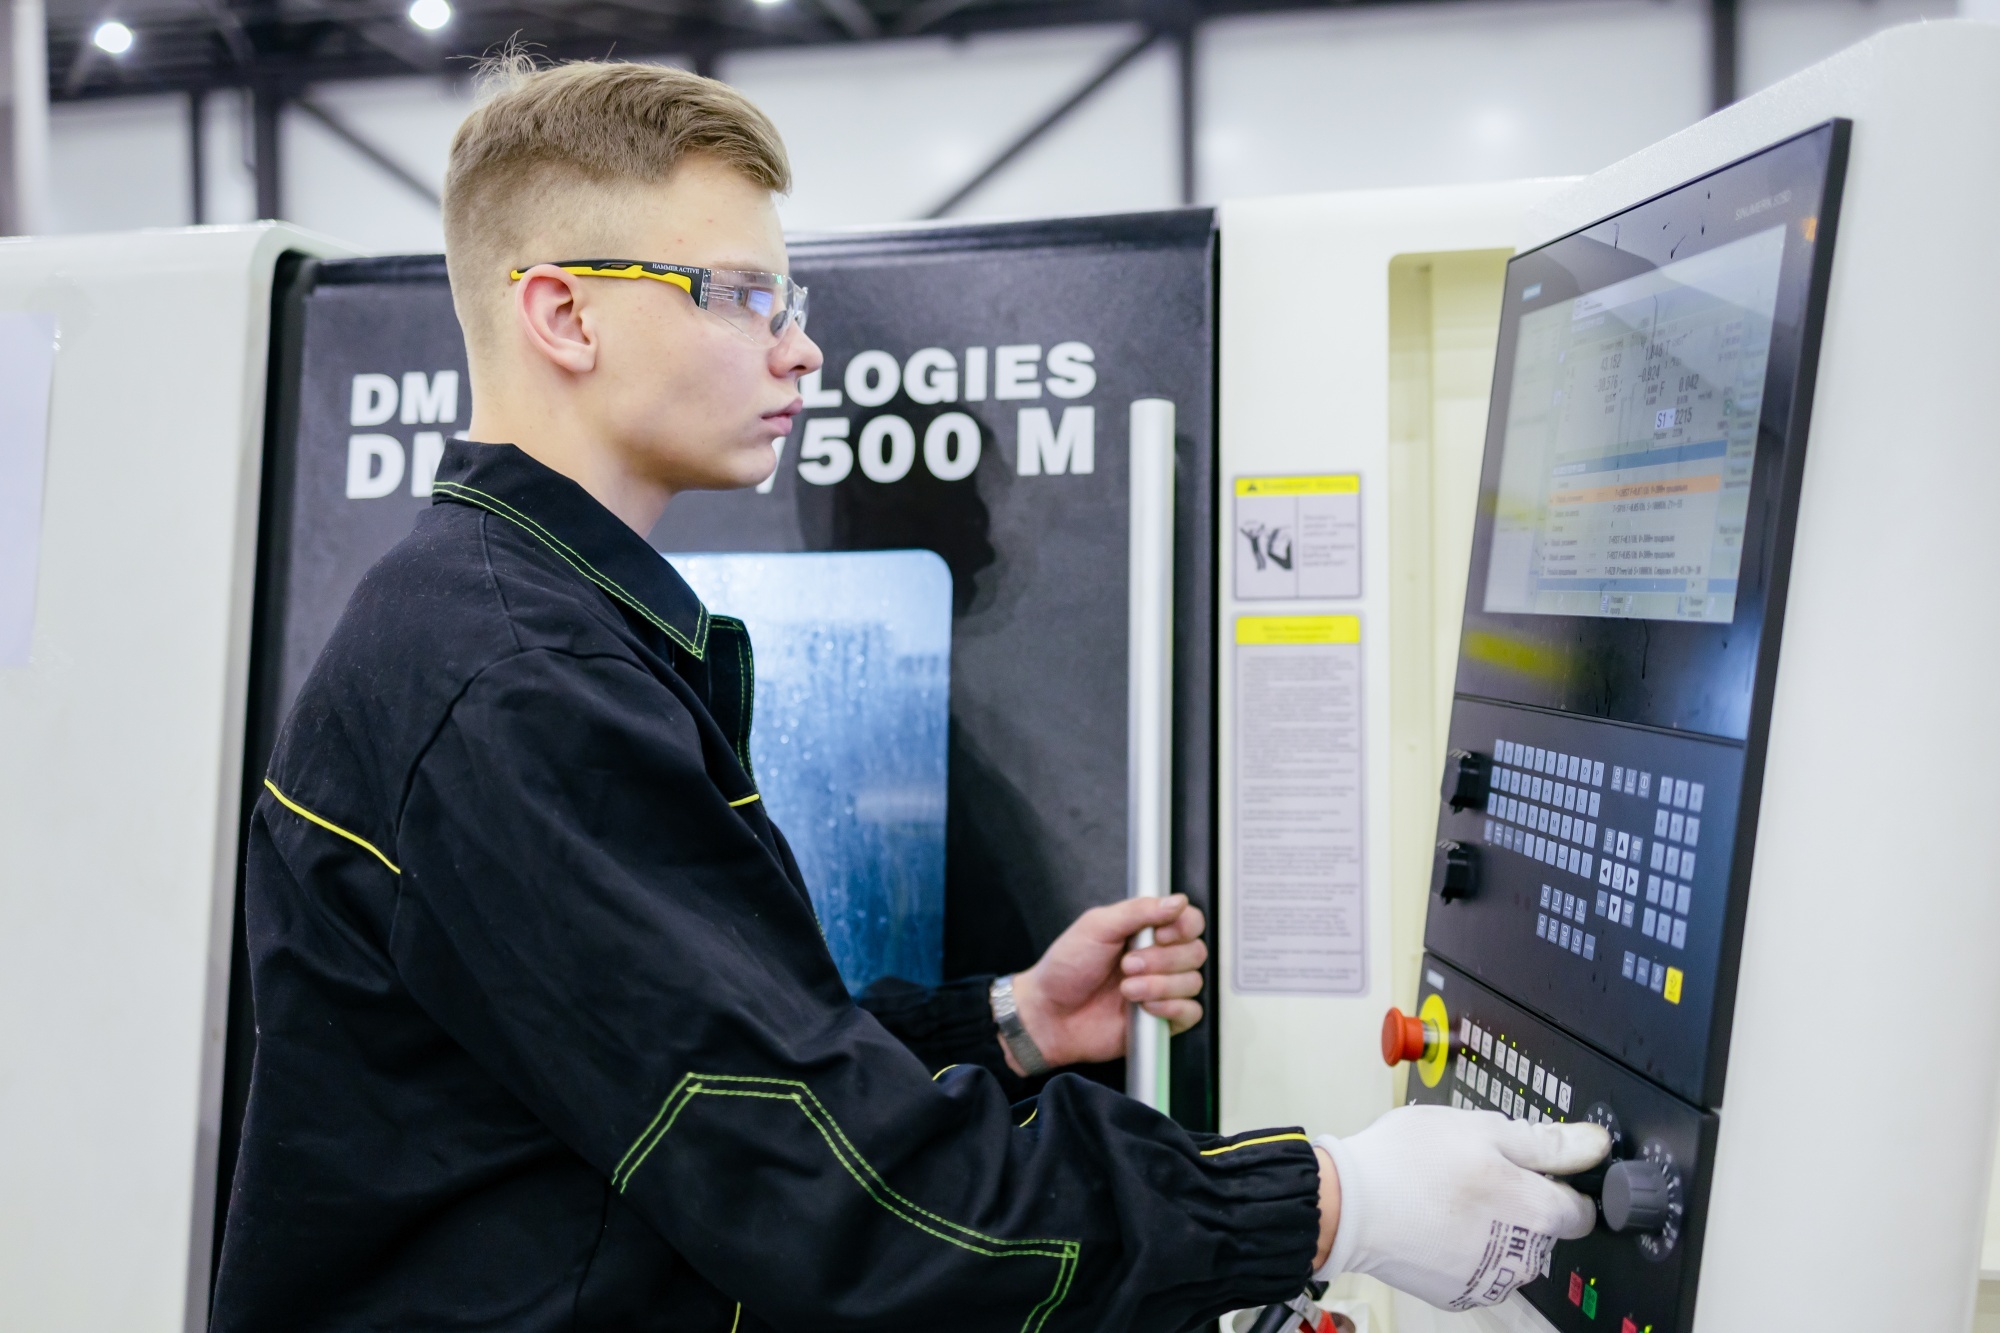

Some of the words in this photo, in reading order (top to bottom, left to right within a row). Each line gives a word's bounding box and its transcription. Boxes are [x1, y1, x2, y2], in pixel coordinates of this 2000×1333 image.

[652, 262, 679, 272] HAMMER
[678, 266, 700, 275] ACTIVE
[1656, 411, 1667, 428] S1
[1674, 406, 1693, 425] 2215
[1016, 405, 1095, 477] M
